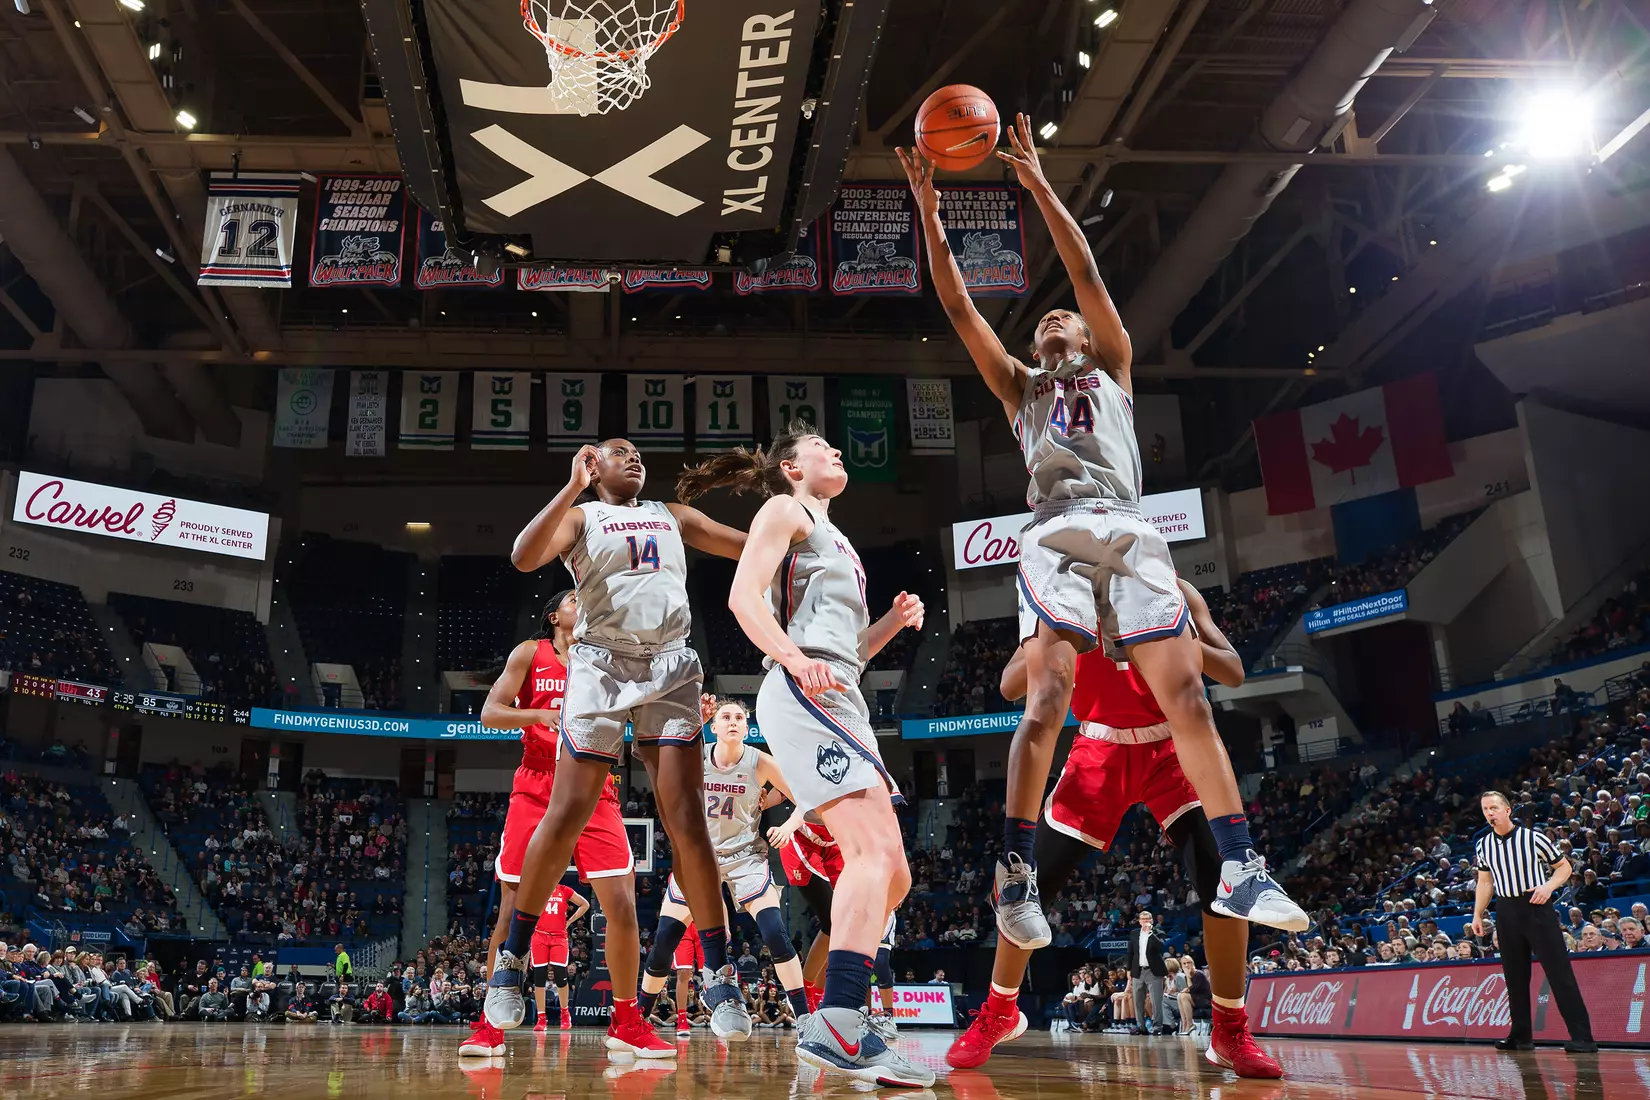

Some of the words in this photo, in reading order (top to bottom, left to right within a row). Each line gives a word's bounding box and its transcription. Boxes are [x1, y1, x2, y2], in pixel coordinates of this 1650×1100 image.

[726, 9, 795, 171] CENTER
[325, 178, 401, 192] 1999-2000
[329, 192, 392, 205] REGULAR
[720, 175, 769, 216] XL
[840, 188, 907, 200] 2003-2004
[942, 190, 1009, 201] 2014-2015
[219, 203, 285, 218] GERNANDER
[843, 199, 903, 210] EASTERN
[332, 206, 387, 219] SEASON
[833, 210, 911, 222] CONFERENCE
[947, 210, 1007, 220] DIVISION
[319, 218, 399, 233] CHAMPIONS
[833, 221, 910, 233] CHAMPIONS
[218, 218, 280, 259] 12
[842, 232, 873, 240] REGULAR
[418, 398, 439, 429] 2
[490, 398, 512, 428] 5
[562, 399, 583, 431] 9
[638, 400, 673, 429] 10
[708, 401, 740, 430] 11
[1050, 395, 1095, 436] 44
[1485, 480, 1510, 496] 241
[25, 480, 145, 534] Carvel
[1152, 512, 1187, 523] SERVED
[180, 520, 220, 535] PROUDLY
[221, 527, 253, 540] SERVED
[602, 521, 672, 535] HUSKIES
[179, 531, 190, 540] AT
[191, 533, 208, 544] THE
[209, 535, 220, 545] XL
[221, 538, 253, 550] CENTER
[8, 546, 30, 561] 232
[625, 534, 661, 572] 14
[1194, 562, 1215, 576] 240
[173, 579, 194, 592] 233
[1347, 611, 1366, 621] DEALS
[1366, 608, 1380, 616] AND
[1379, 602, 1404, 613] OFFERS
[1308, 618, 1331, 629] Hilton
[86, 688, 101, 698] 43
[113, 691, 135, 705] 2:39
[142, 697, 156, 707] 85
[233, 709, 250, 717] 2:44
[273, 713, 409, 733] FINDMYGENIUS3D.COM
[707, 795, 735, 820] 24
[545, 902, 559, 915] 44
[1112, 940, 1128, 948] LIGHT
[903, 991, 946, 1003] DUNK
